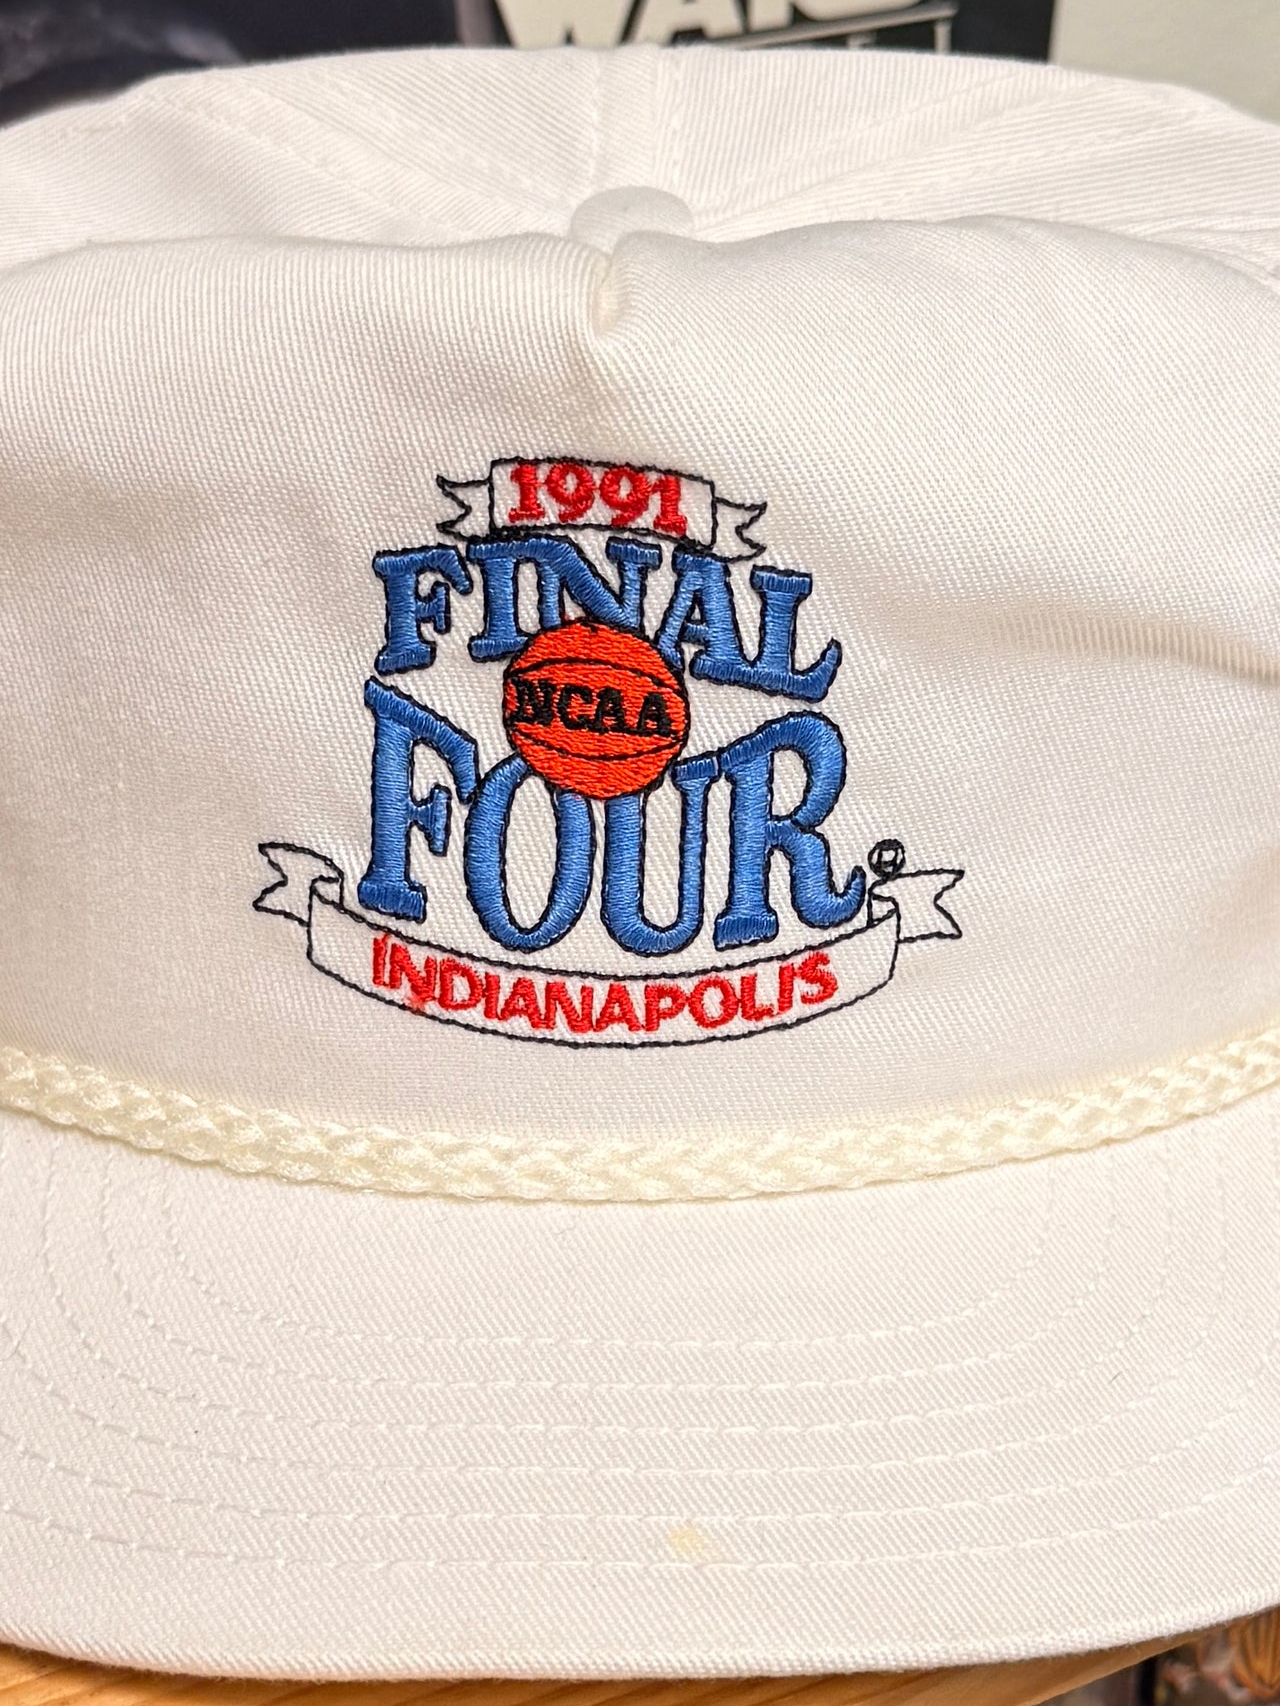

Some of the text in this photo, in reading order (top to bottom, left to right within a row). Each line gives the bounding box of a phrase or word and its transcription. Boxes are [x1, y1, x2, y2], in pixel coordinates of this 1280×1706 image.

[508, 460, 689, 536] 1991
[373, 533, 844, 704] FINAL
[510, 677, 673, 739] NCAA
[356, 676, 867, 959] FOUR
[371, 933, 840, 1034] INDIANAPOLIS
